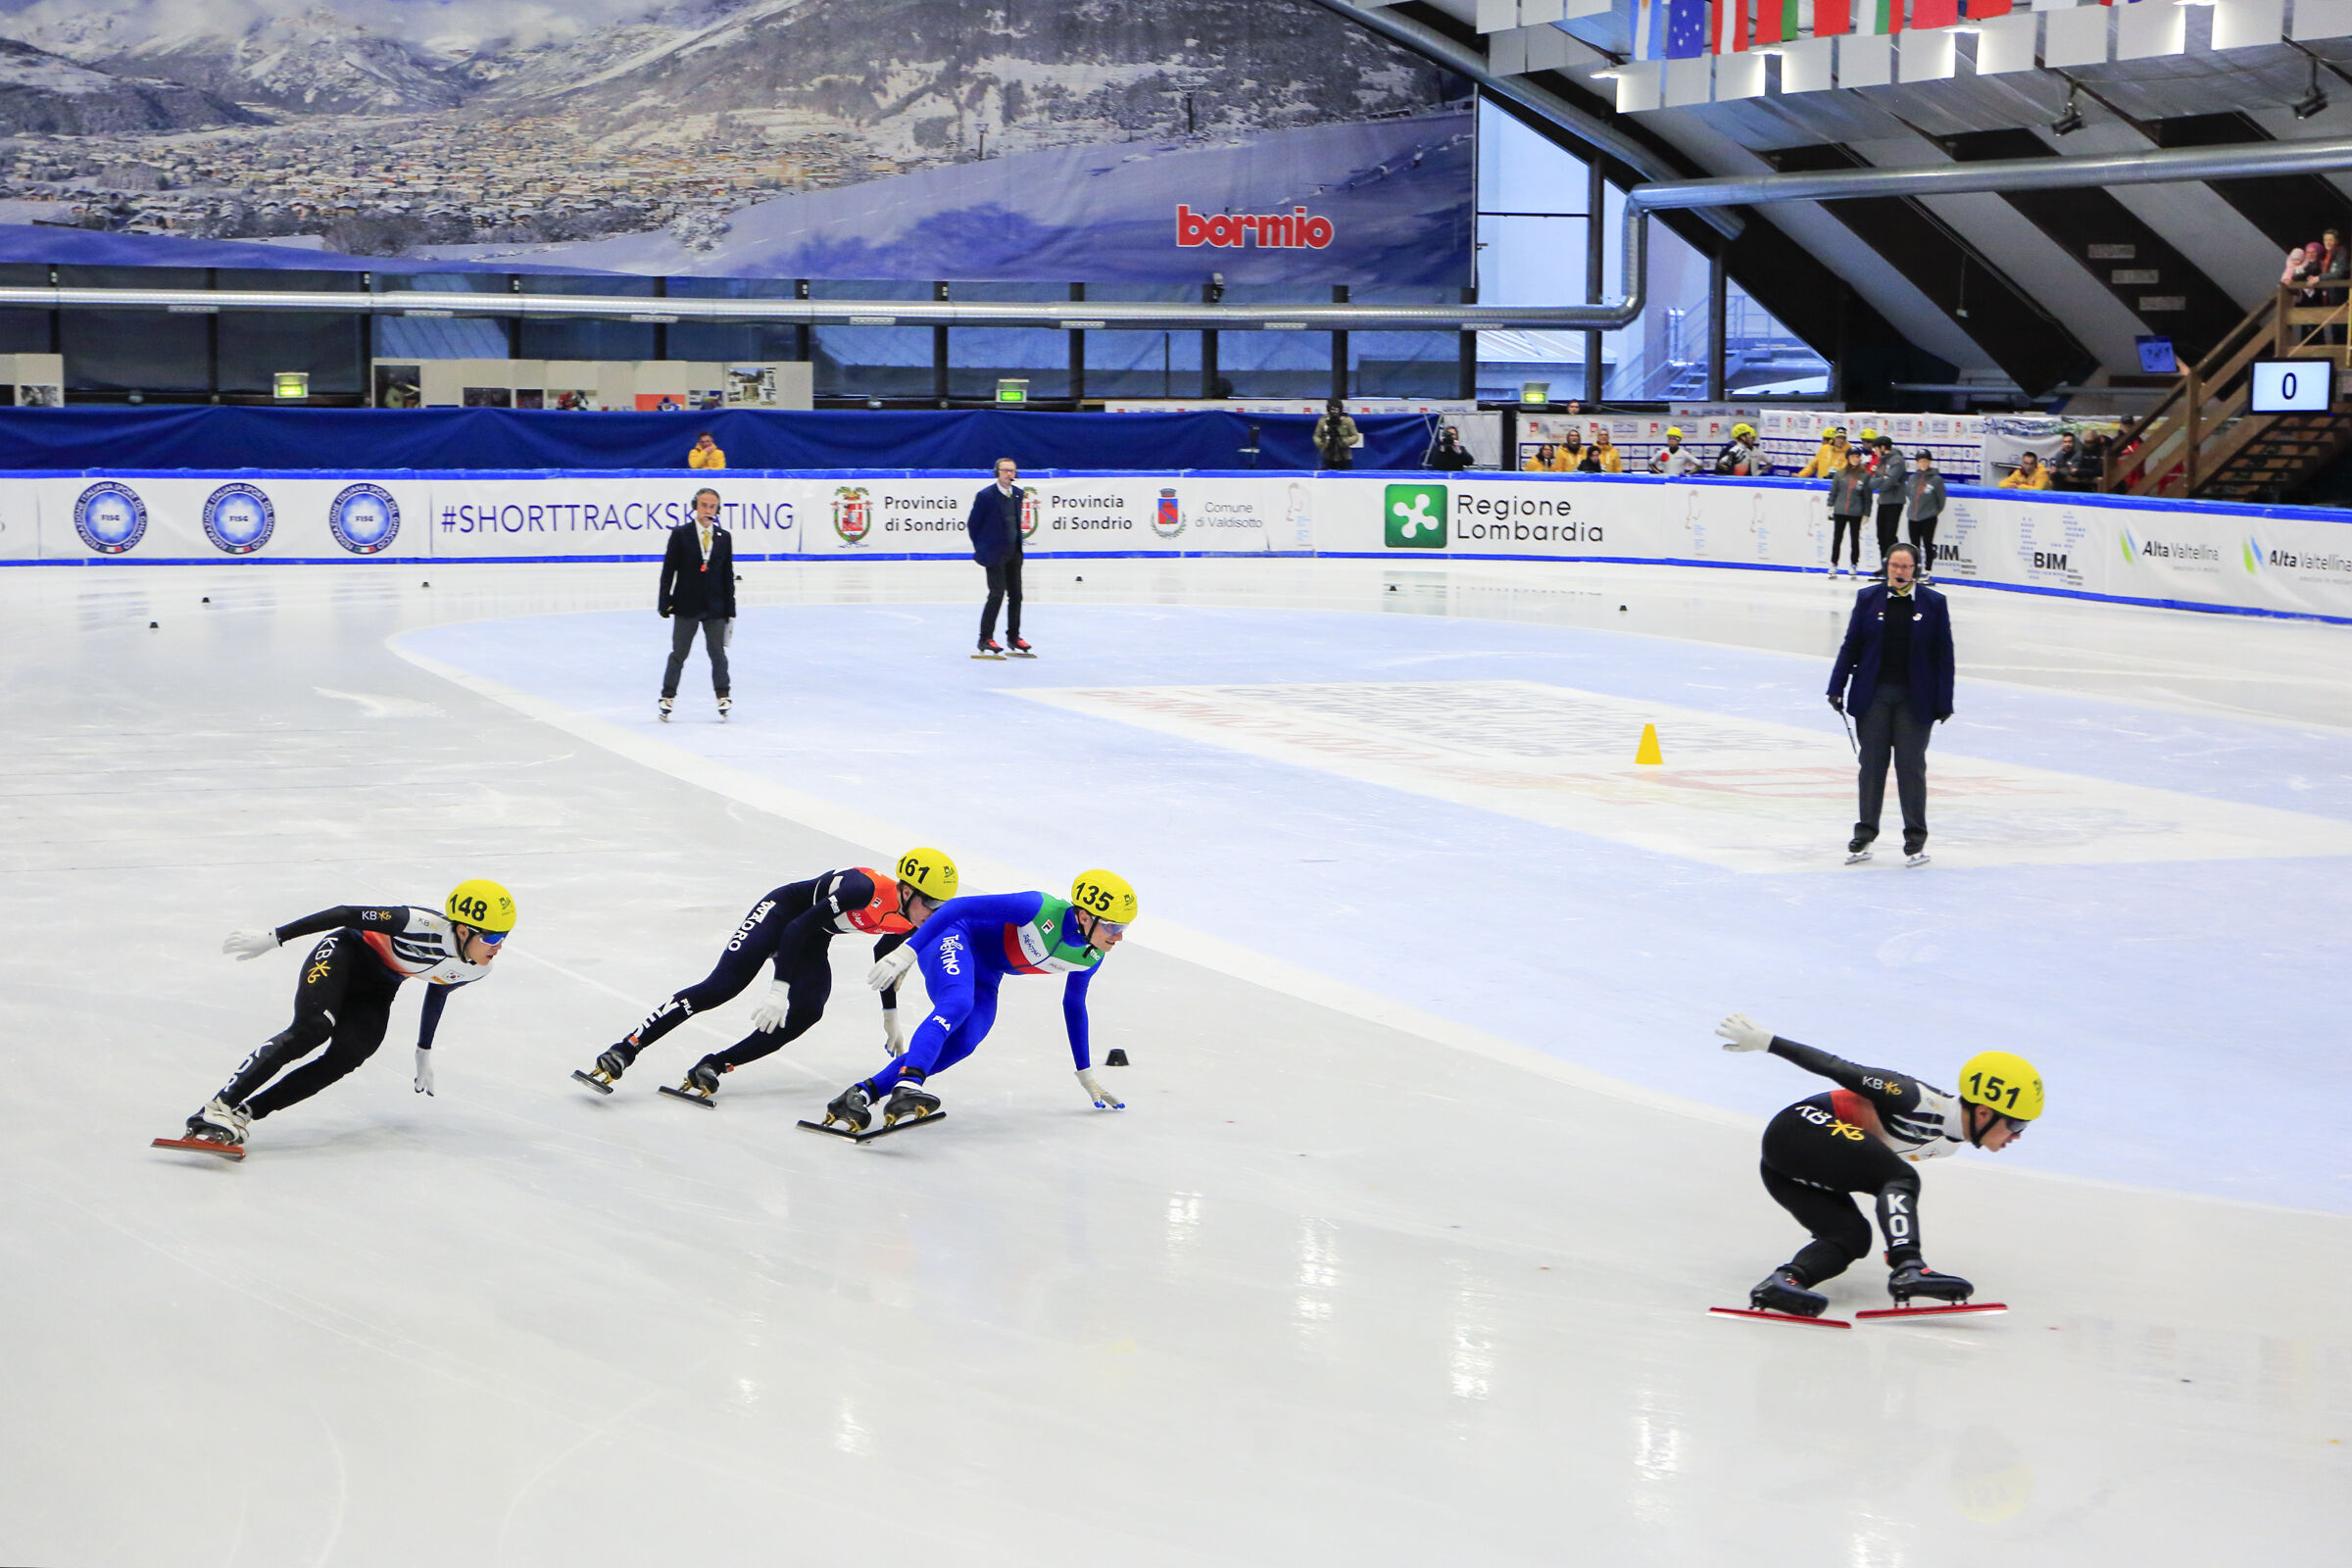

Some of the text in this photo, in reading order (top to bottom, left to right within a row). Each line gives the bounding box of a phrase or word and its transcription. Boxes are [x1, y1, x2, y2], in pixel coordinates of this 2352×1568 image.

[1177, 204, 1334, 249] bormio
[2282, 372, 2297, 400] 0
[884, 495, 958, 510] Provincia
[1052, 494, 1124, 510] Provincia
[1205, 501, 1253, 514] Comune
[1457, 494, 1572, 519] Regione
[885, 516, 967, 532] di Sondrio
[1052, 514, 1133, 530] di Sondrio
[1196, 516, 1263, 529] di Valdisotto
[1457, 519, 1604, 542] Lombardia
[2034, 552, 2067, 570] BIM
[2142, 541, 2220, 562] Alta Valtellina
[2269, 550, 2297, 567] Alta
[898, 856, 930, 884] 161
[1076, 883, 1114, 911] 135
[449, 894, 487, 921] 148
[933, 1015, 952, 1031] FILA
[1969, 1072, 2021, 1109] 151
